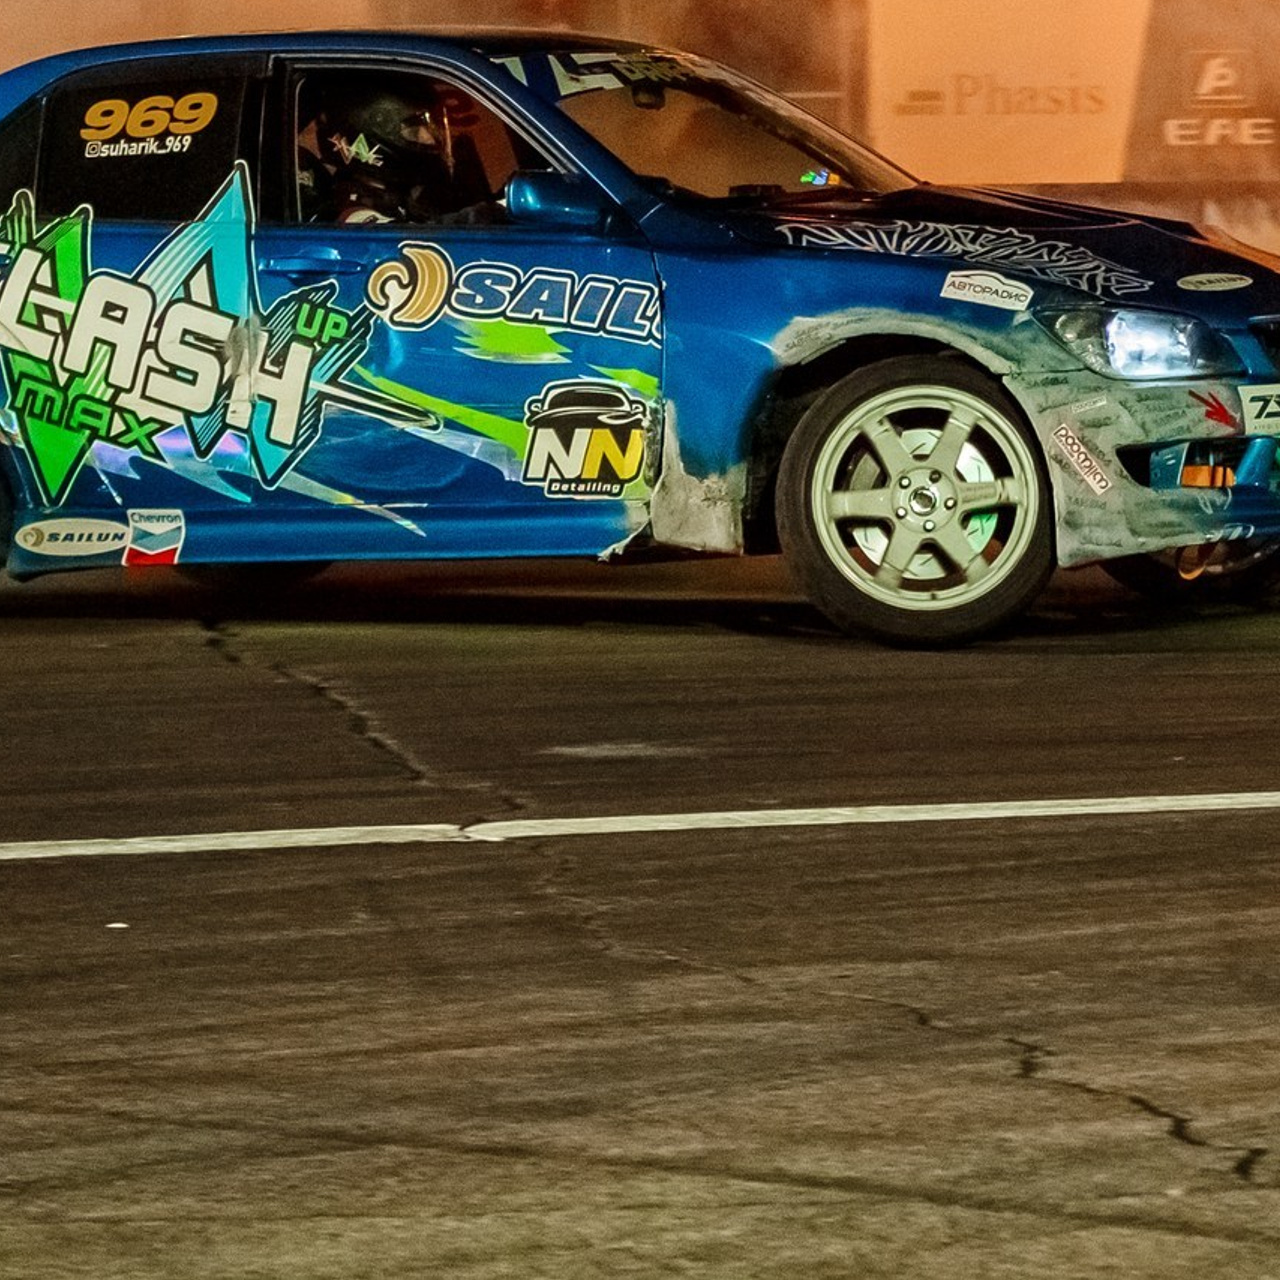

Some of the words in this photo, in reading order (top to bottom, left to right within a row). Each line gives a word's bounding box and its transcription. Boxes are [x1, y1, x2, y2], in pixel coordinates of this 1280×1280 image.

[80, 92, 218, 140] 969
[954, 74, 1106, 116] Phasis
[296, 302, 349, 344] UP
[450, 263, 662, 344] SAIL
[0, 246, 313, 446] LASH
[526, 428, 644, 480] NN
[550, 482, 621, 494] Detailing
[46, 532, 126, 543] SAILUN
[130, 512, 182, 524] Chevron
